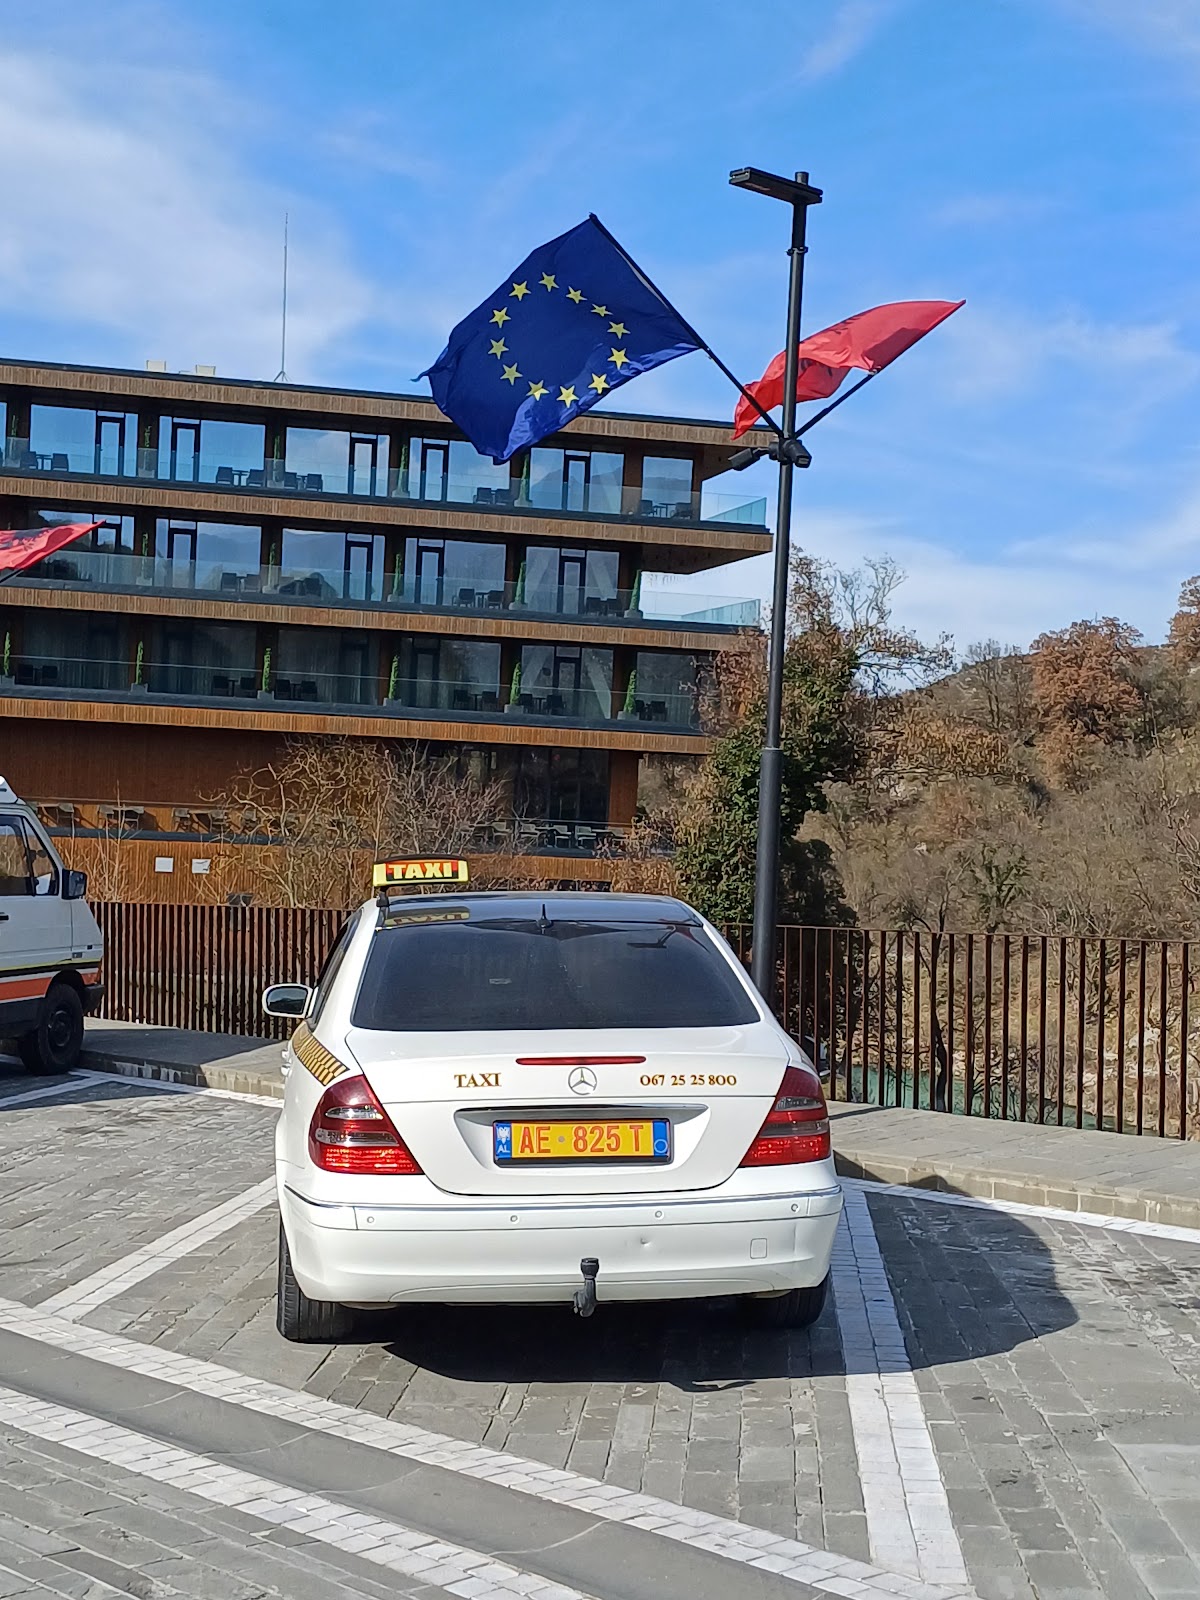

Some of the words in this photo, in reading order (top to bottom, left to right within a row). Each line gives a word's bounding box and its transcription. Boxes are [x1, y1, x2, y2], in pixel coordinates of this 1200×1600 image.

[388, 862, 453, 880] TAXI
[454, 1072, 502, 1088] TAXI
[640, 1074, 665, 1087] 067
[670, 1074, 686, 1087] 25
[690, 1074, 705, 1087] 25
[708, 1074, 737, 1087] 800
[520, 1126, 551, 1154] AE
[573, 1125, 621, 1153] 825
[629, 1125, 644, 1152] T
[497, 1145, 511, 1154] AL
